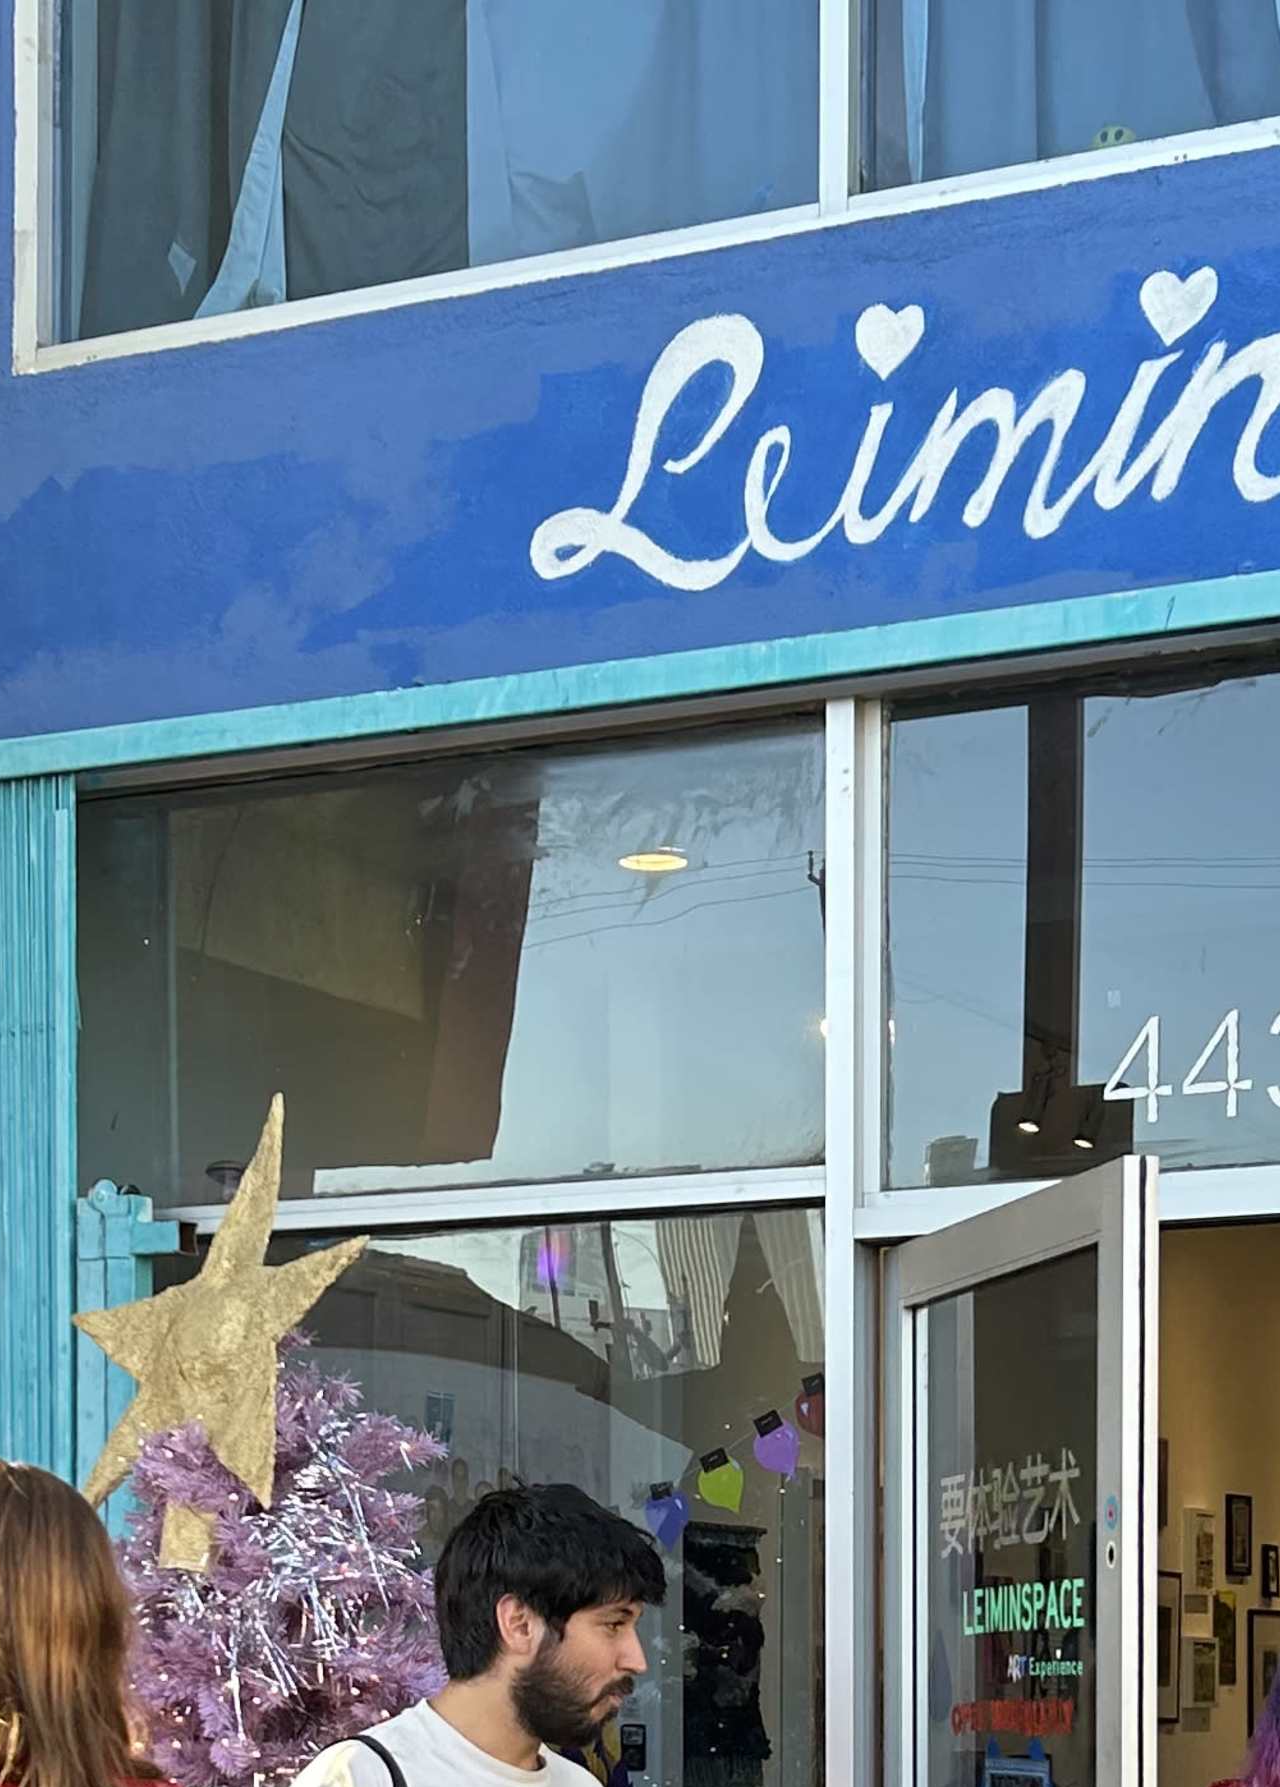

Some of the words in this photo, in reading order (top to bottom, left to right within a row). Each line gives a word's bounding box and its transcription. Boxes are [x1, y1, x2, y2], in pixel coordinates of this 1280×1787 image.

[940, 1448, 1081, 1559] 要体验艺术
[963, 1577, 1086, 1636] LEIMINSPACE
[1028, 1656, 1084, 1681] Experience
